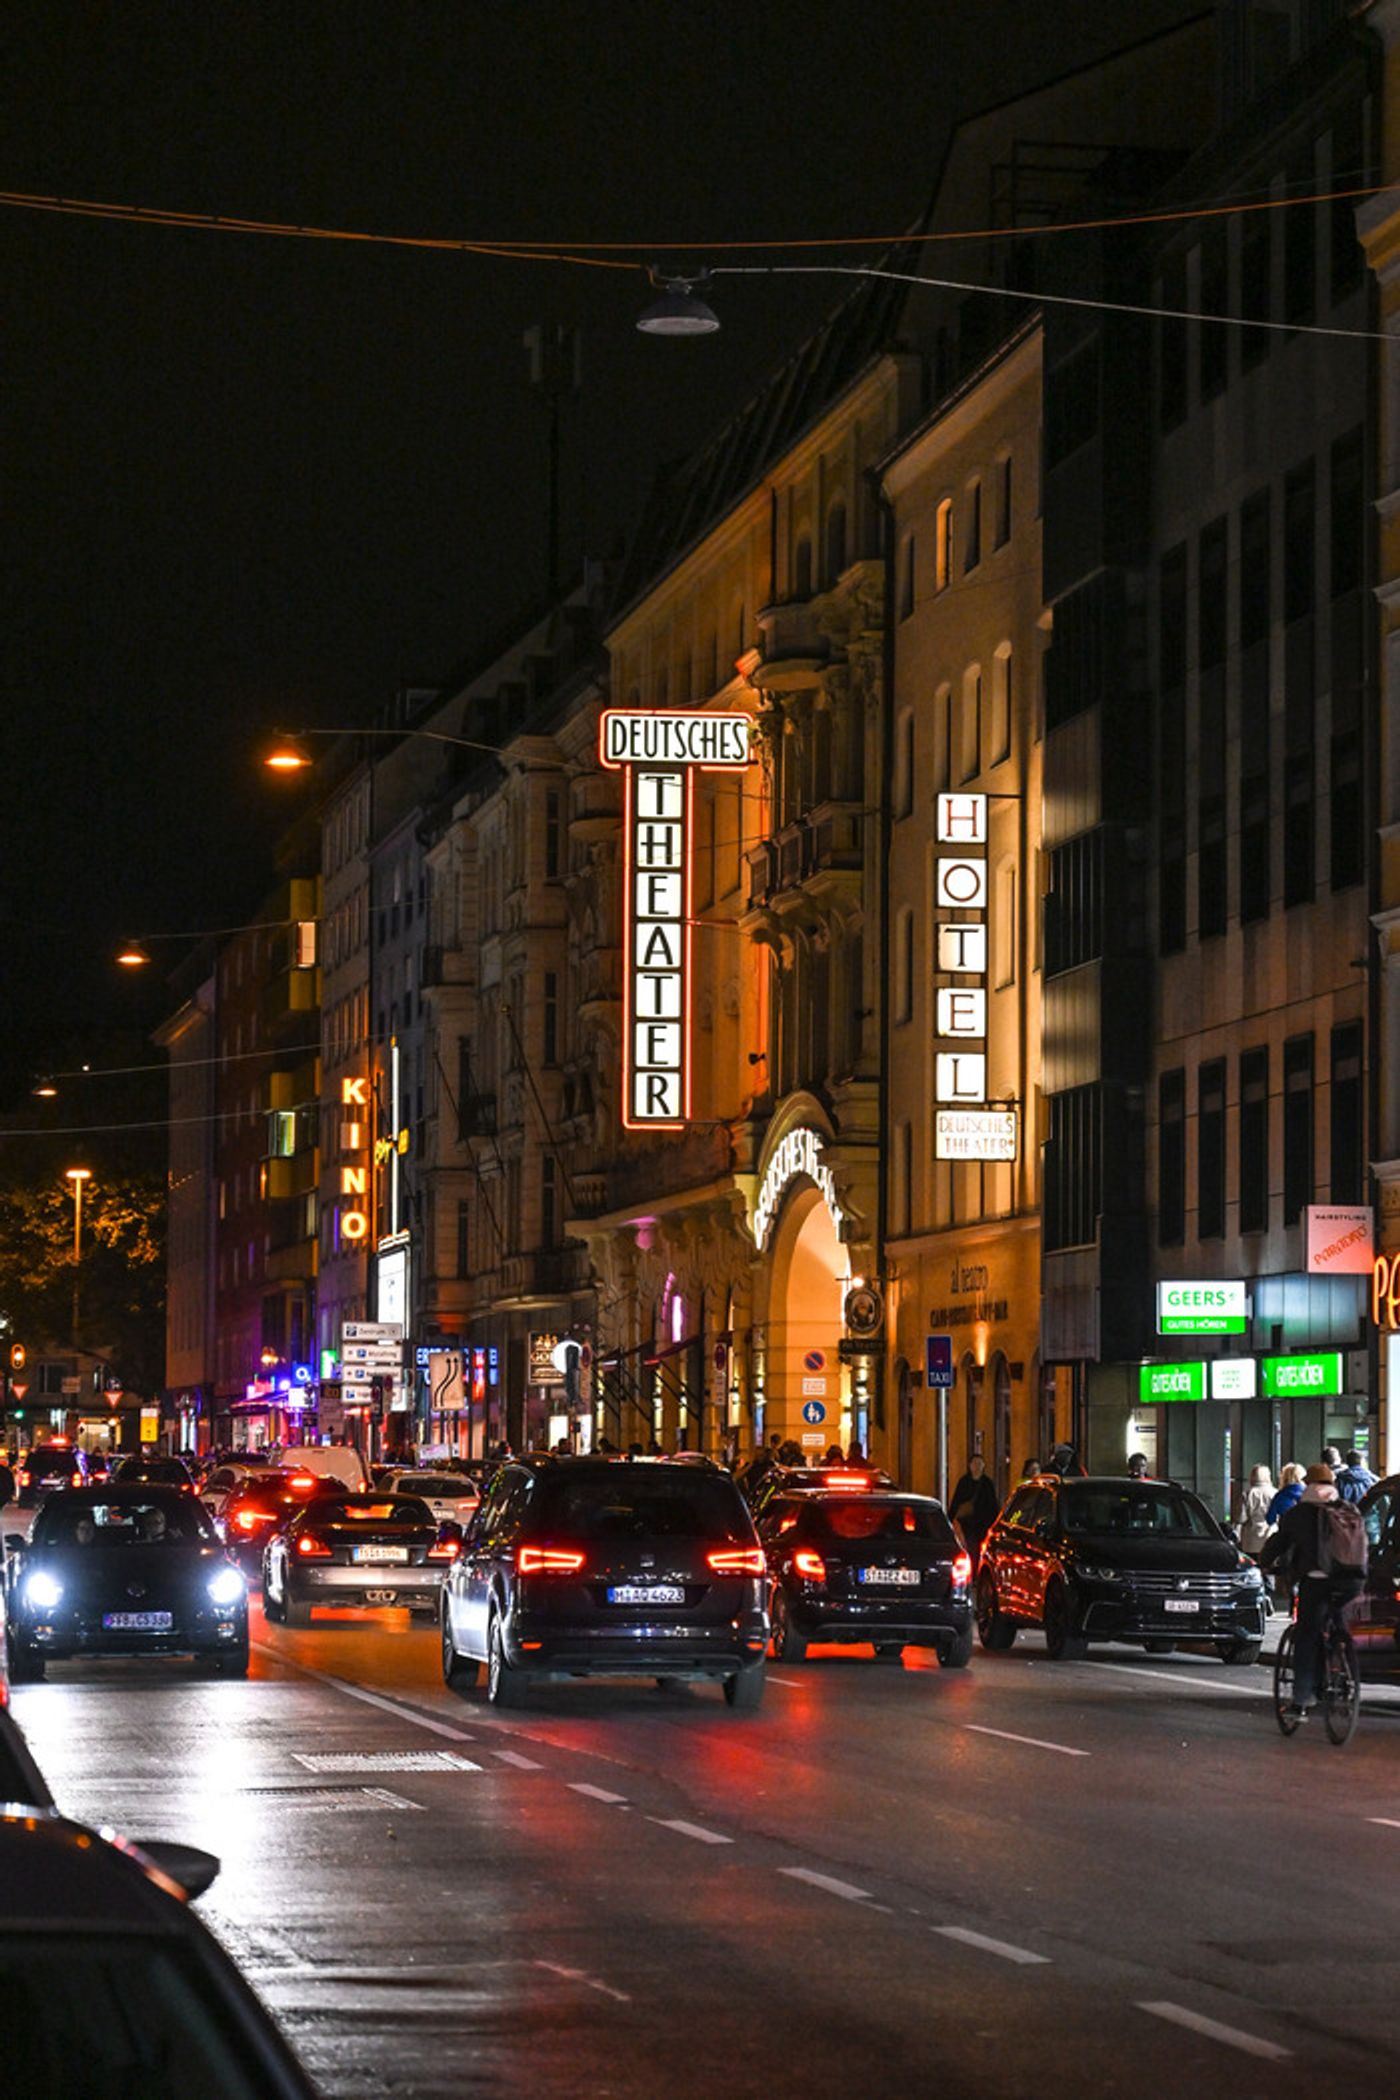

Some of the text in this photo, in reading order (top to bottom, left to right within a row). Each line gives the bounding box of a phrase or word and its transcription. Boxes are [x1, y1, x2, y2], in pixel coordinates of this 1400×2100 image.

[611, 718, 745, 760] DEUTSCHES
[640, 775, 676, 1116] THEATER
[943, 799, 981, 1097] HOTEL
[341, 1077, 368, 1239] KINO
[1167, 1290, 1227, 1306] GEERS
[929, 1371, 950, 1383] TAXI
